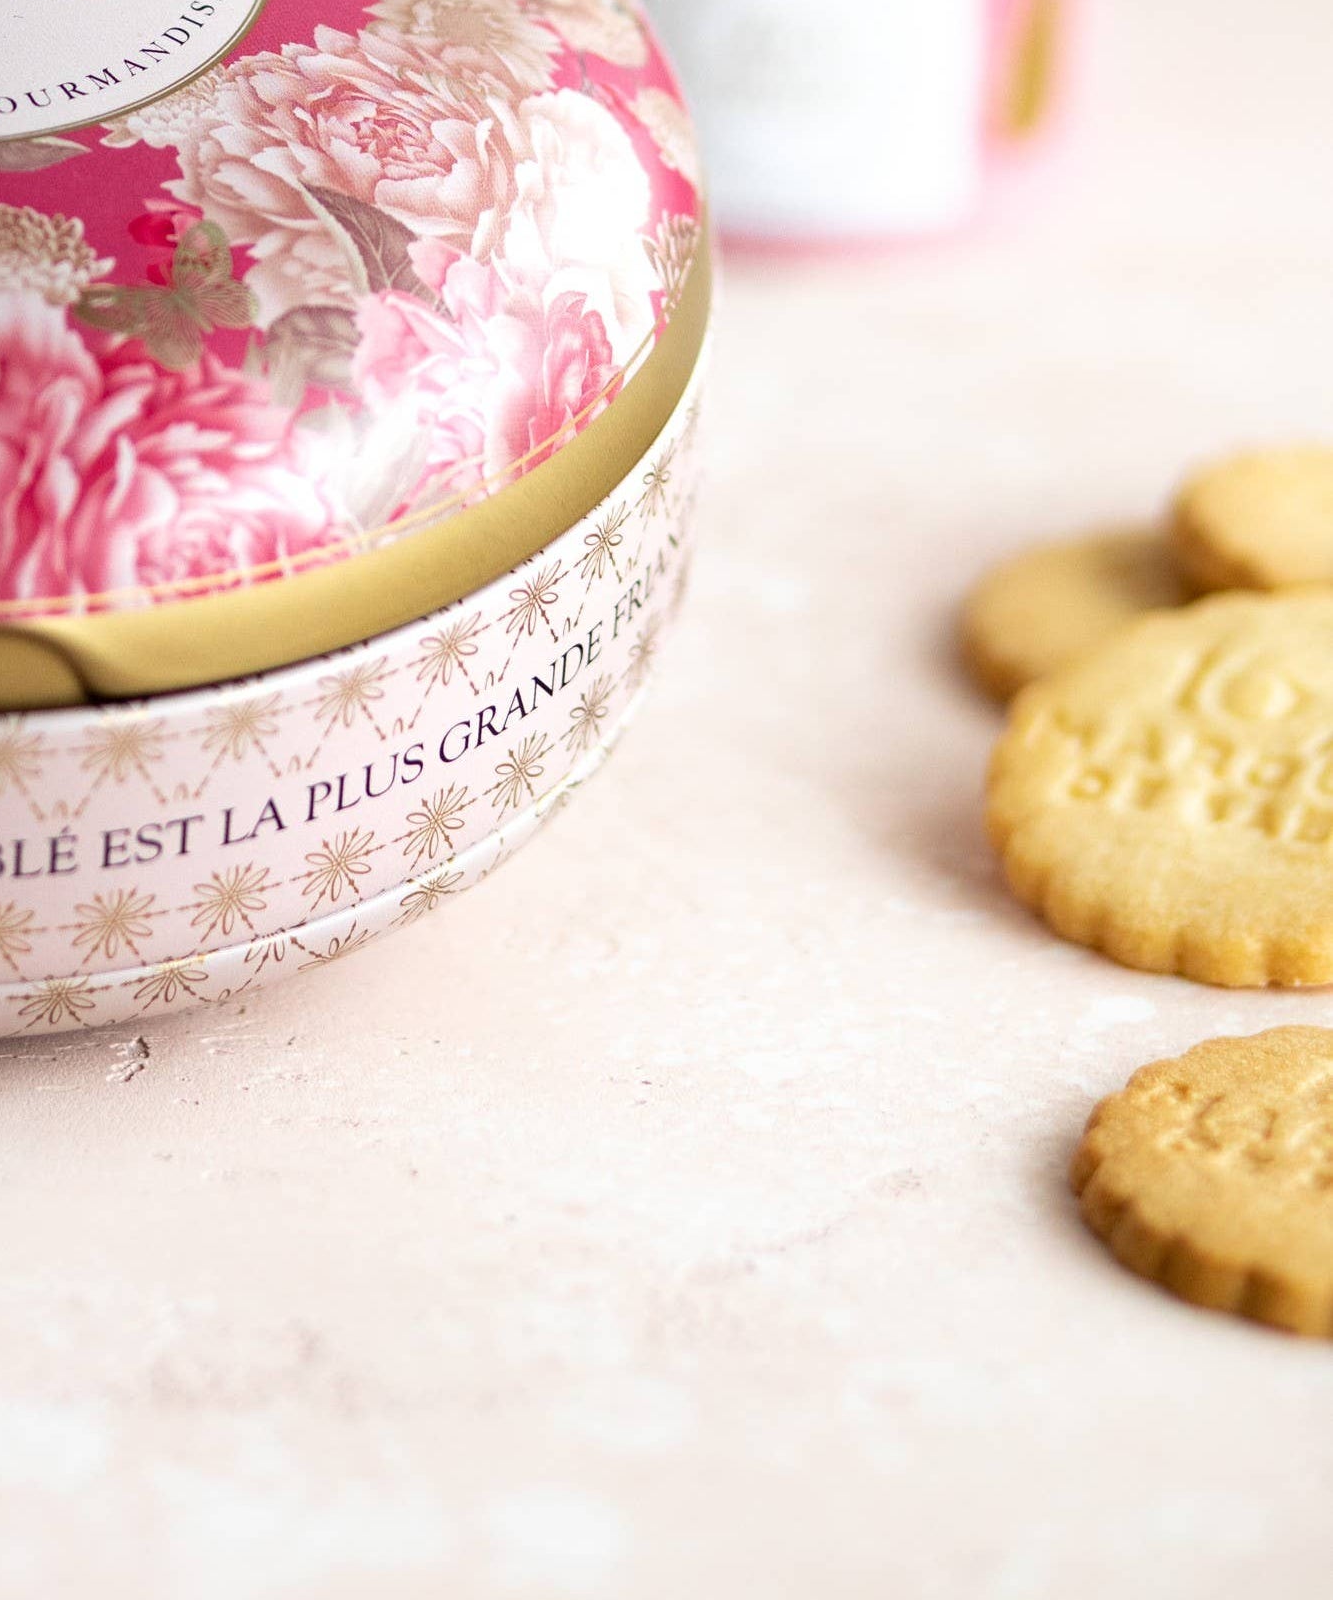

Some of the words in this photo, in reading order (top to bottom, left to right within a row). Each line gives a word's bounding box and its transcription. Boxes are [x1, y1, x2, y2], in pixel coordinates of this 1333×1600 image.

[101, 814, 204, 869] EST
[219, 795, 286, 847] LA
[304, 742, 425, 823] PLUS
[437, 621, 603, 764] GRANDE
